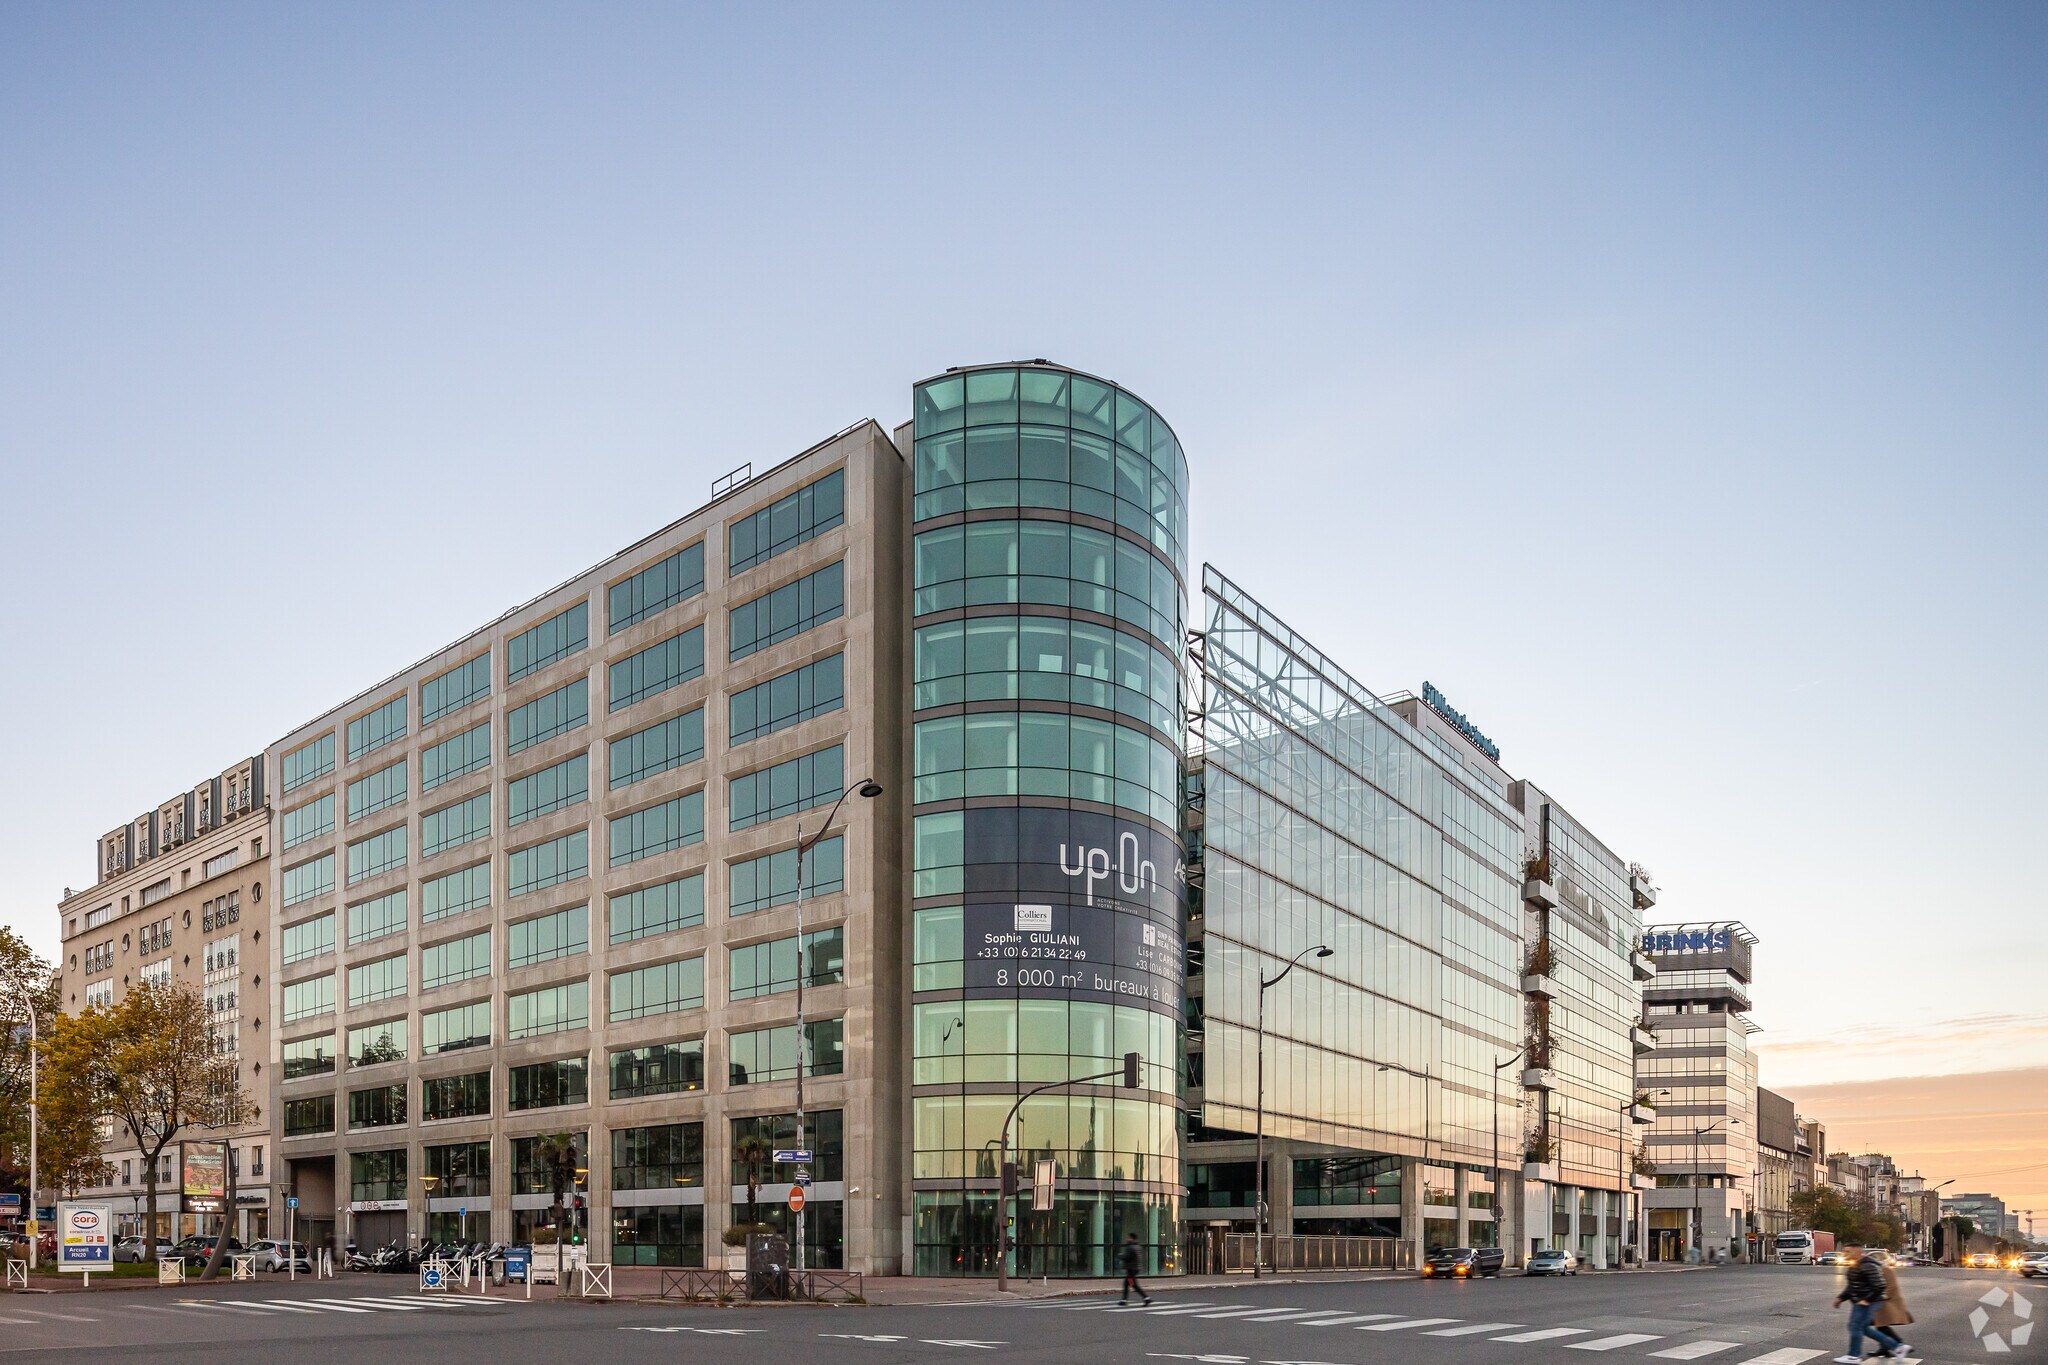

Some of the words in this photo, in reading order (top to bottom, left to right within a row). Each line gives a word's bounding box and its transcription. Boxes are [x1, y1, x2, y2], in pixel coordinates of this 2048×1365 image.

[1017, 910, 1047, 919] Colliers
[984, 933, 1022, 945] Sophie
[1030, 933, 1080, 946] GIULIANI
[1642, 931, 1730, 952] BRINKS
[977, 947, 999, 958] +33
[1003, 946, 1018, 958] (0)
[1021, 948, 1029, 958] 6
[1031, 948, 1043, 958] 21
[1043, 948, 1057, 959] 34
[1058, 949, 1072, 959] 22
[1074, 949, 1086, 961] 49
[1137, 945, 1154, 959] Lise
[1135, 959, 1148, 970] +33
[996, 969, 1009, 986] 8
[1018, 969, 1054, 986] 000
[1094, 973, 1149, 999] bureaux
[1153, 984, 1159, 1000] à
[1161, 986, 1180, 1008] louer
[73, 1216, 97, 1224] cora
